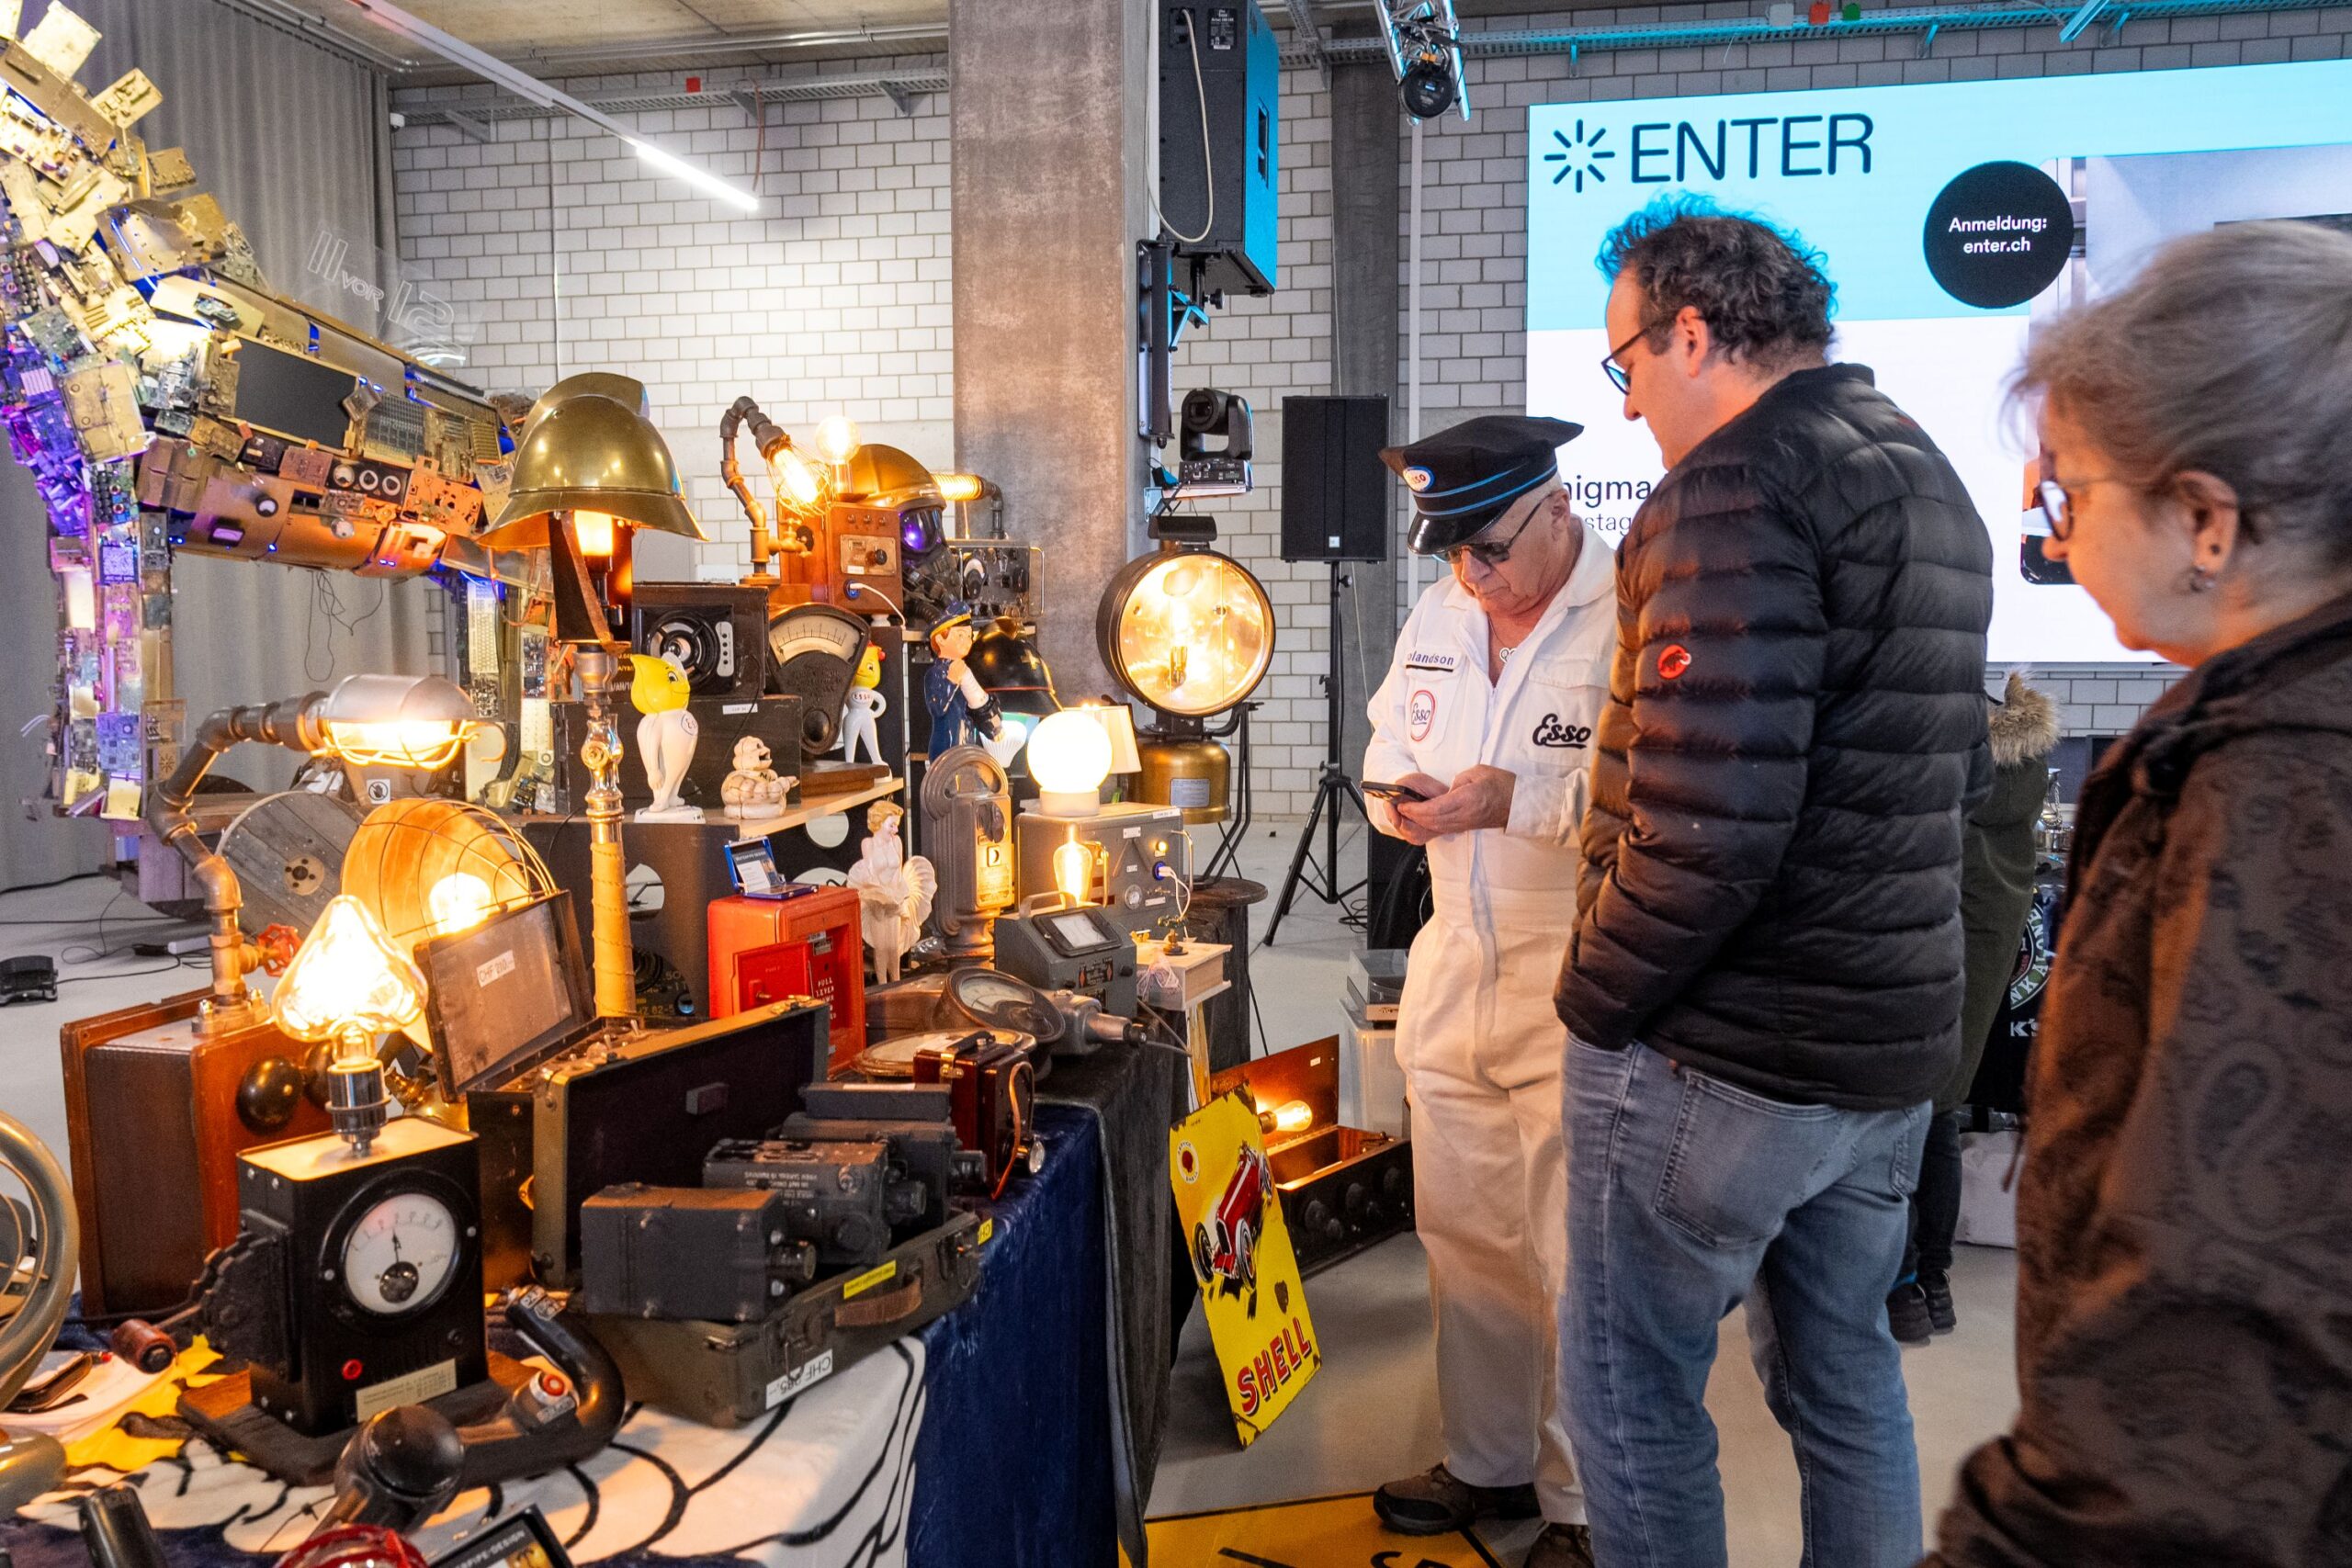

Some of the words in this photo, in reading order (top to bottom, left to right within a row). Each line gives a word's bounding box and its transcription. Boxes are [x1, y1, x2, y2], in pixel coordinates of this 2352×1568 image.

[1631, 113, 1873, 184] ENTER
[1948, 215, 2047, 232] Anmeldung:
[1963, 236, 2030, 254] enter.ch
[342, 270, 384, 312] VOR
[1412, 702, 1430, 725] Esso
[1532, 713, 1591, 750] Esso
[805, 1355, 831, 1376] CHF
[1237, 1315, 1312, 1417] SHELL
